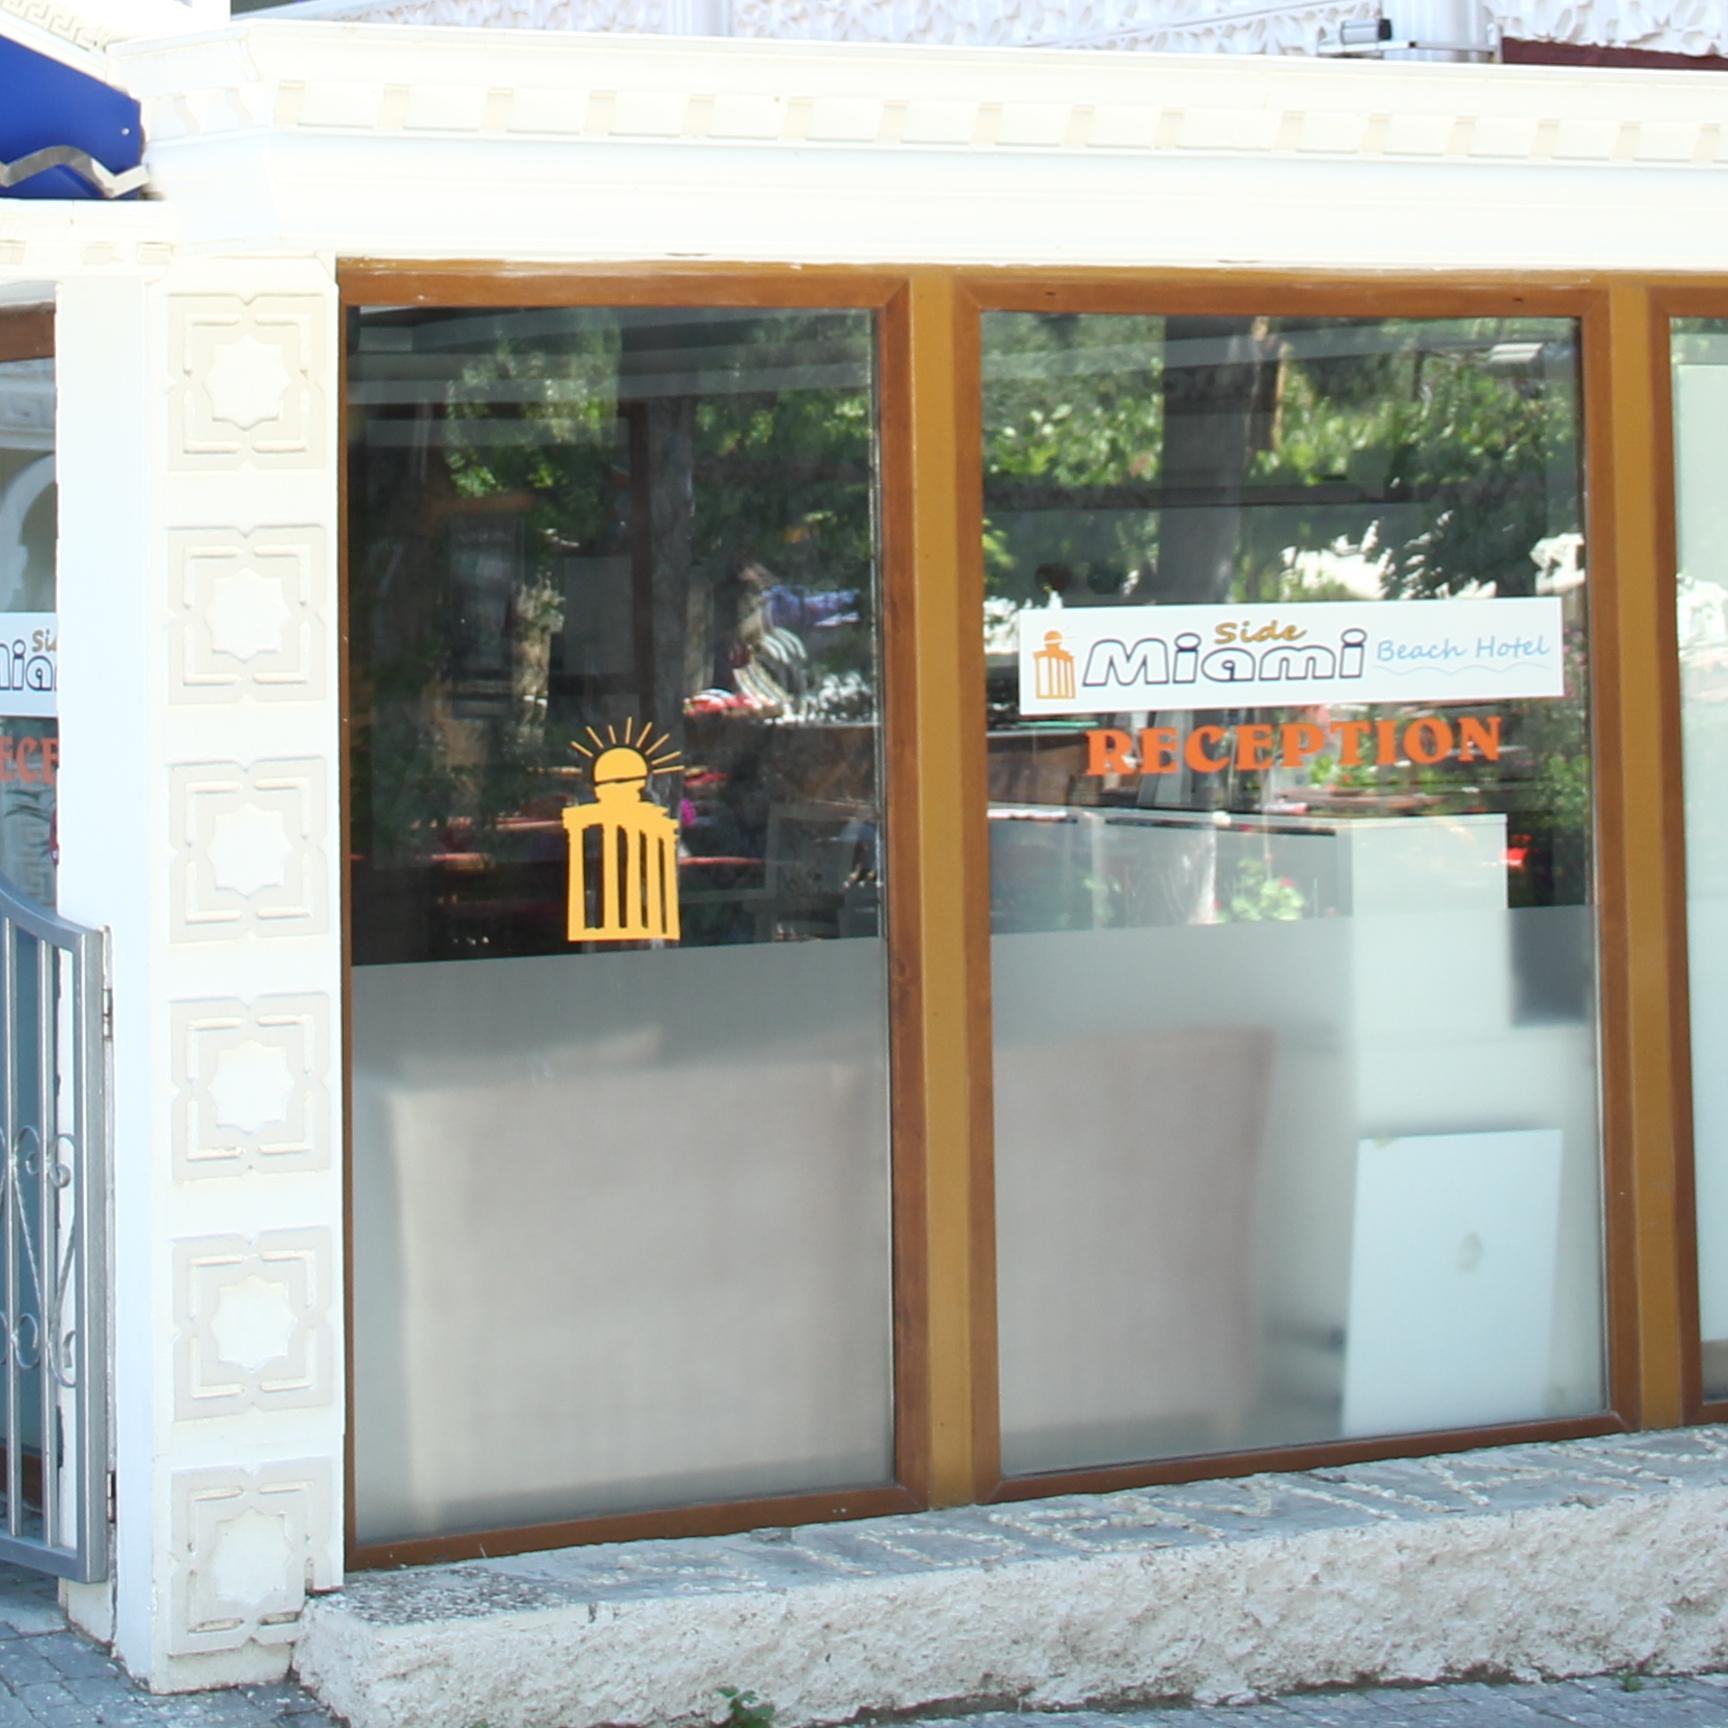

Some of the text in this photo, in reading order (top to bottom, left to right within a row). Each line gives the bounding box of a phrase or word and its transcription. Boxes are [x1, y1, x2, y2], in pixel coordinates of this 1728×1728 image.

[1082, 628, 1552, 687] Miami Beach Hotel
[1214, 620, 1307, 645] Side
[1084, 715, 1503, 777] RECEPTION
